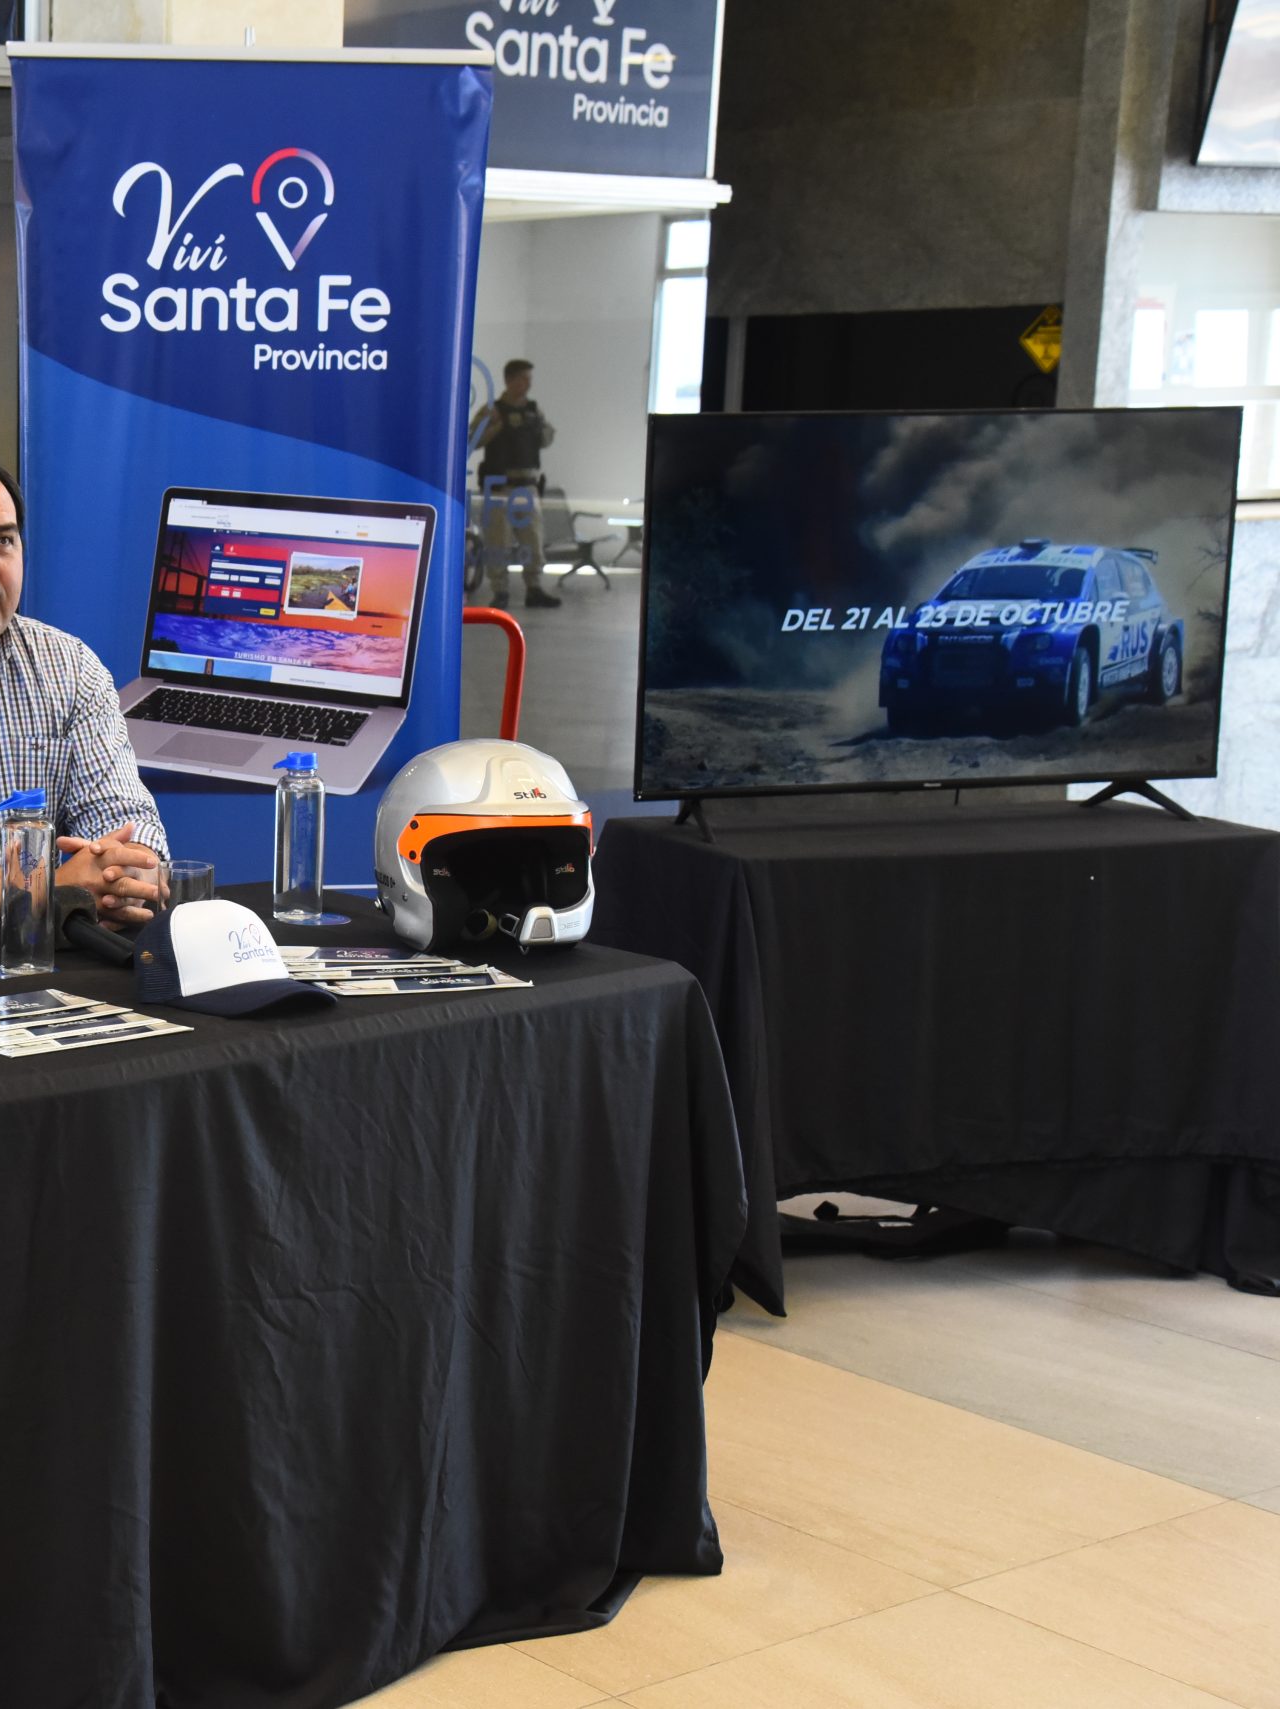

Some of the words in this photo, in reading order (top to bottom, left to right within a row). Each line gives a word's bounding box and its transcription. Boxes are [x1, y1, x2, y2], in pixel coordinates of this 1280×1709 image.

[465, 10, 609, 84] Santa
[619, 27, 674, 89] Fe
[573, 92, 669, 128] Provincia
[112, 161, 245, 272] Vivi
[100, 272, 298, 333] Santa
[317, 274, 391, 333] Fe
[254, 343, 388, 371] Provincia
[781, 608, 834, 632] DEL
[841, 606, 871, 630] 21
[873, 605, 909, 629] AL
[915, 605, 947, 628] 23
[953, 603, 991, 627] DE
[999, 600, 1130, 627] OCTUBRE
